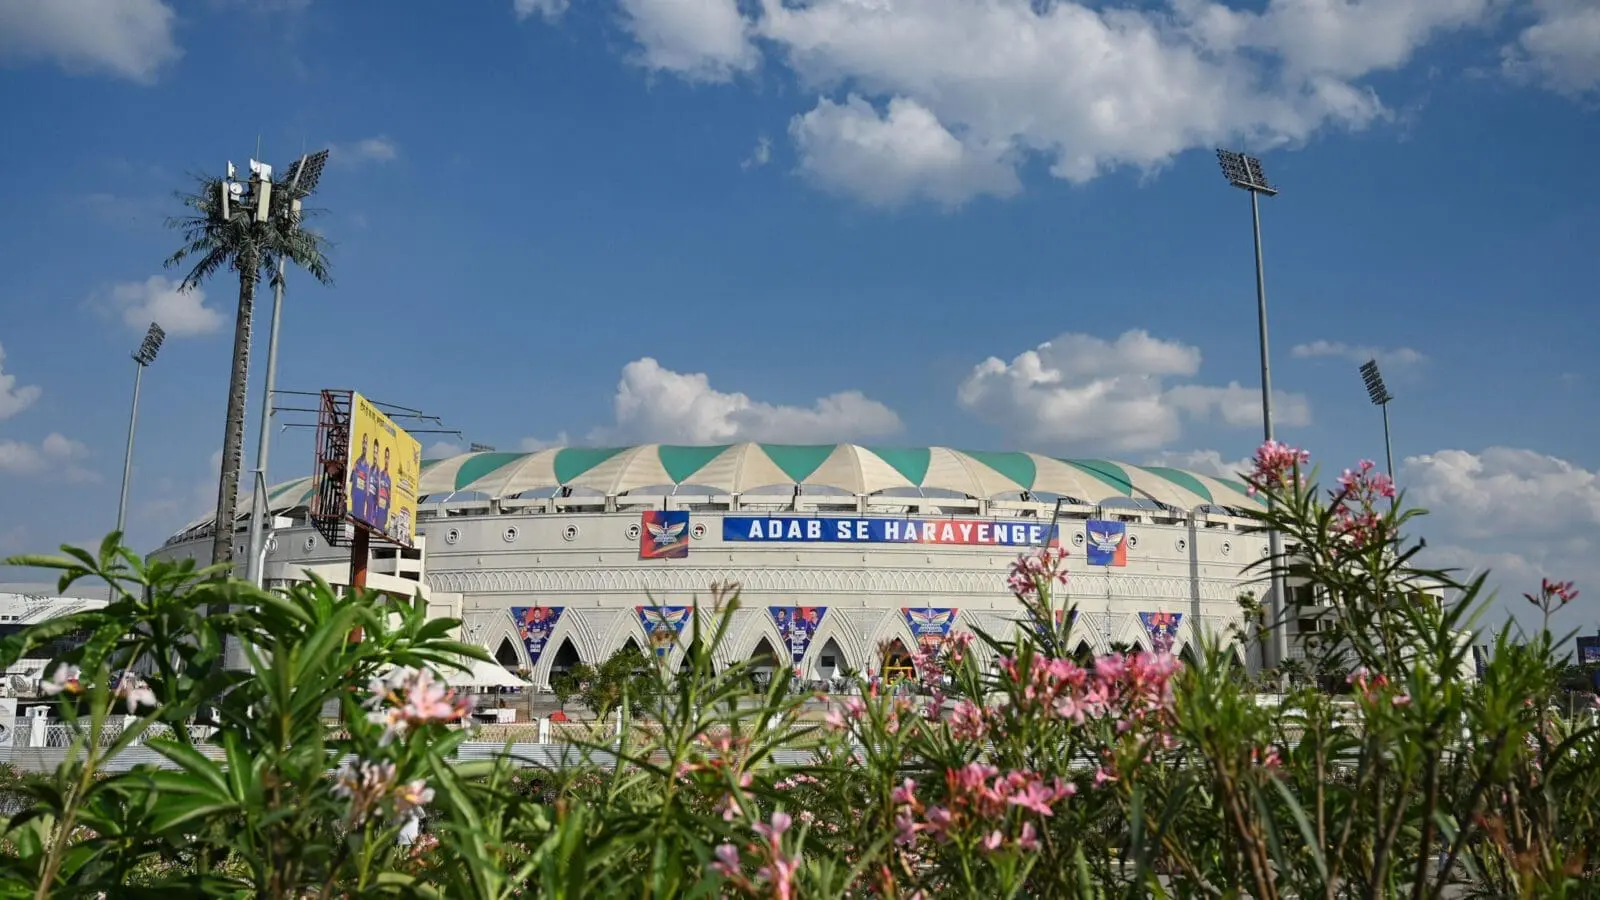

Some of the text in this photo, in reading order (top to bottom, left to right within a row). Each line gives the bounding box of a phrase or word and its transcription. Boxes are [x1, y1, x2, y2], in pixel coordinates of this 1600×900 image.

[749, 519, 1042, 544] ADAB SE HARAYENGE
